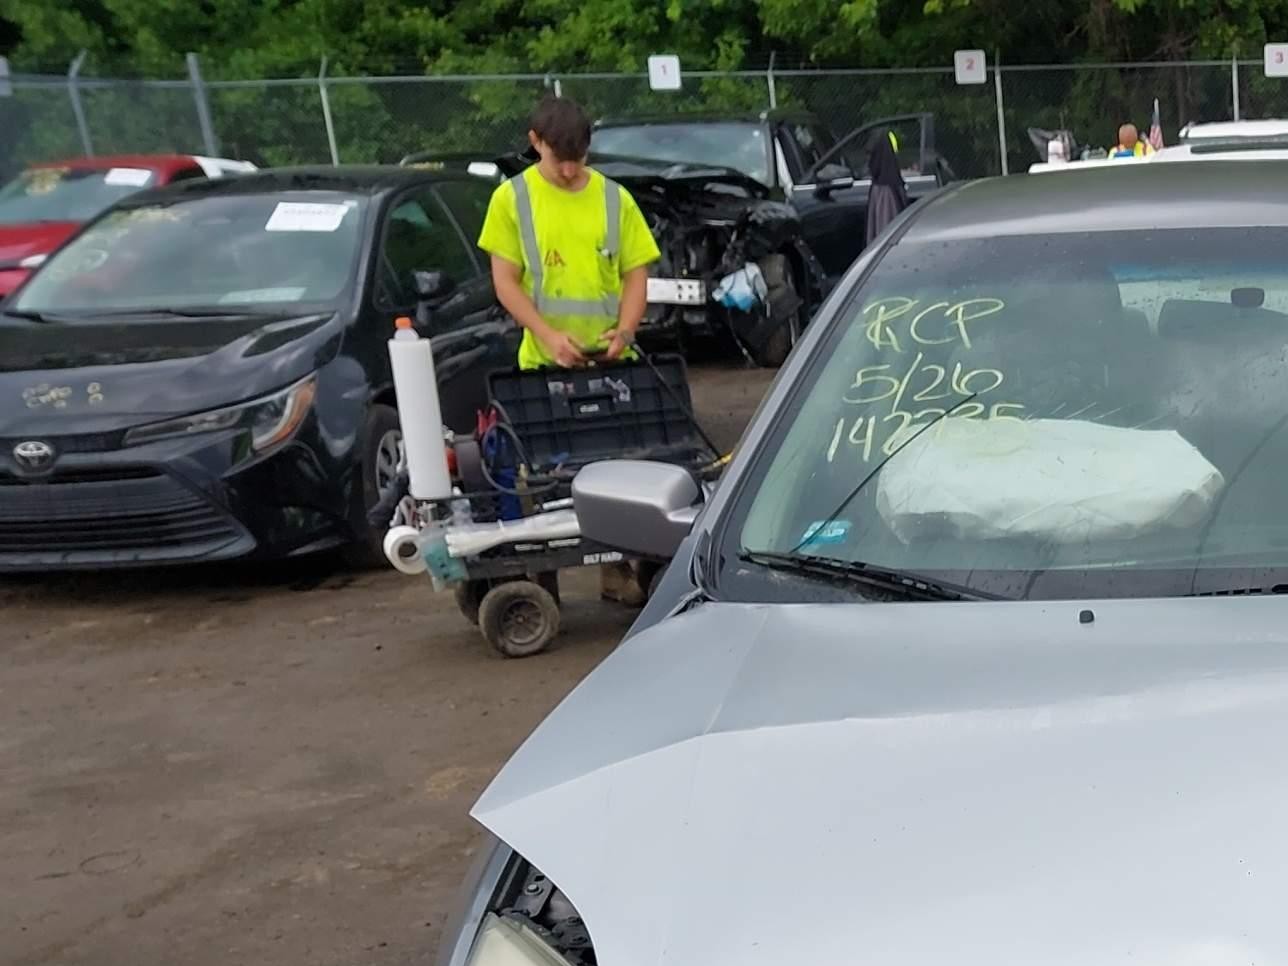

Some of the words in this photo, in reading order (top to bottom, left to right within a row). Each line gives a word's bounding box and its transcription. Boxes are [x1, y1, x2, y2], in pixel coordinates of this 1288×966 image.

[1275, 51, 1284, 64] 3
[661, 65, 668, 75] 1
[966, 58, 975, 70] 2
[842, 352, 1004, 413] 5/26
